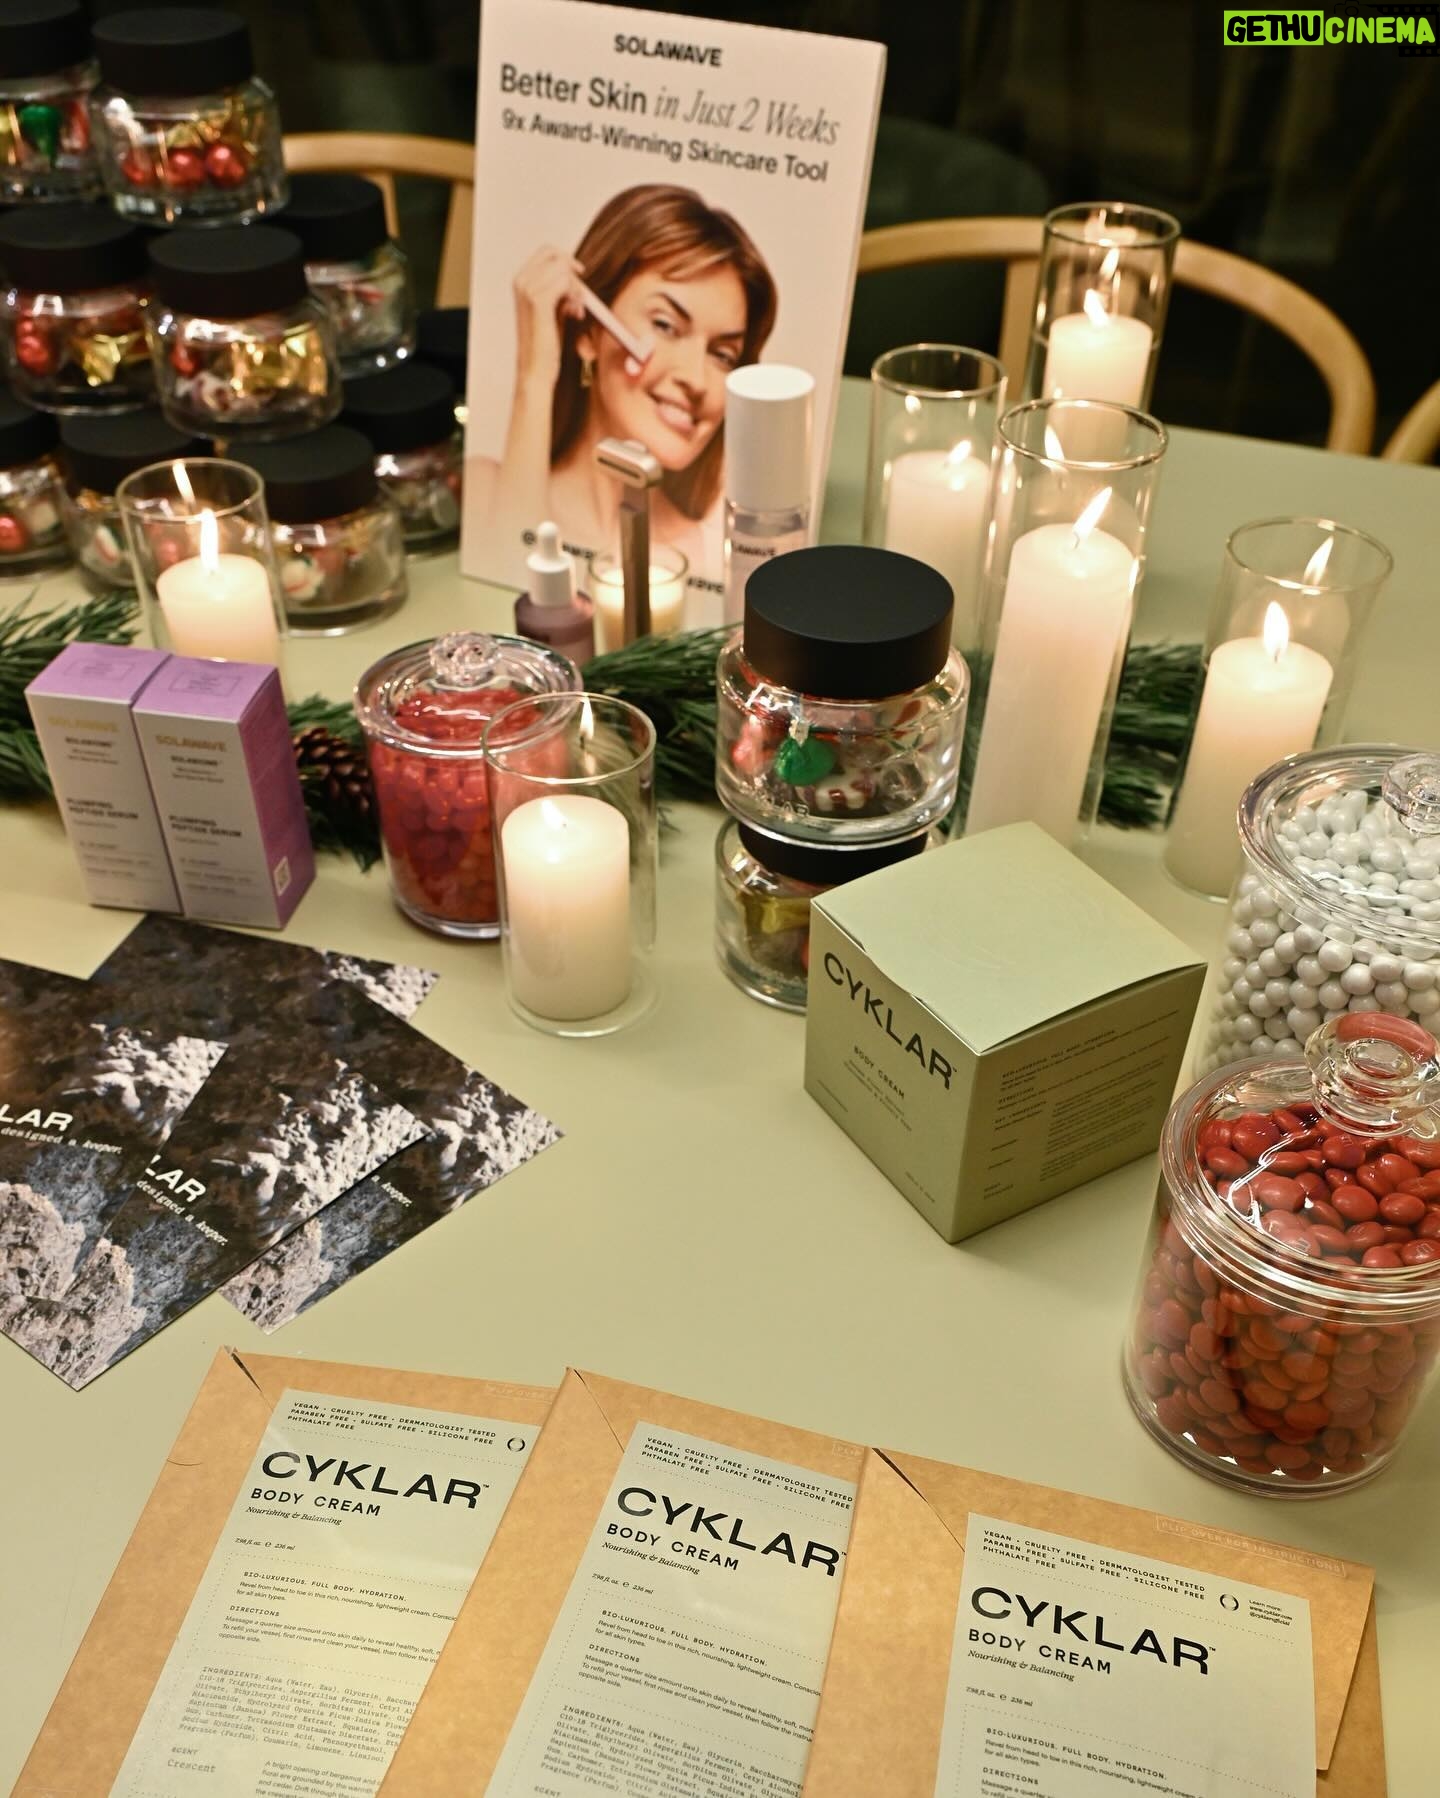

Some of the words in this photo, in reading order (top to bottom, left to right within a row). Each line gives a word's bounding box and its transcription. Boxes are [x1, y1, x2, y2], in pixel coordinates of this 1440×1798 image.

[614, 34, 722, 67] SOLAWAVE
[501, 64, 580, 102] Better
[588, 77, 646, 116] Skin
[654, 86, 678, 120] in
[683, 90, 734, 130] Just
[738, 98, 760, 133] 2
[764, 101, 840, 145] Weeks
[502, 110, 525, 132] 9x
[530, 117, 682, 162] Award-Winning
[688, 140, 778, 174] Skincare
[785, 154, 828, 182] Tool
[854, 1046, 874, 1069] BODY
[878, 1070, 905, 1099] CREAM
[1, 1126, 63, 1144] designed
[136, 1180, 186, 1216] designed
[185, 1214, 193, 1222] a
[287, 1415, 331, 1426] PHTHALATE
[290, 1408, 325, 1418] PARABEN
[360, 1419, 392, 1428] SULFATE
[428, 1430, 469, 1440] SILICONE
[330, 1407, 364, 1416] CRUELTY
[399, 1418, 464, 1432] DERMATOLOGIST
[468, 1428, 496, 1437] TESTED
[641, 1451, 685, 1468] PHTHALATE
[690, 1465, 709, 1474] FREE
[644, 1444, 679, 1458] PARABEN
[684, 1455, 703, 1465] FREE
[715, 1465, 747, 1478] SULFATE
[752, 1476, 772, 1485] FREE
[783, 1485, 826, 1502] SILICONE
[830, 1499, 850, 1509] FREE
[647, 1437, 672, 1448] VEGAN
[684, 1448, 718, 1461] CRUELTY
[722, 1459, 742, 1469] FREE
[754, 1468, 820, 1492] DERMATOLOGIST
[824, 1489, 853, 1502] TESTED
[245, 1506, 290, 1518] Nourishing
[300, 1513, 342, 1526] Balancing
[250, 1487, 304, 1504] BODY
[314, 1496, 380, 1516] CREAM
[601, 1541, 648, 1560] Nourishing
[657, 1557, 700, 1575] Balancing
[606, 1523, 660, 1546] BODY
[671, 1541, 739, 1570] CREAM
[983, 1545, 1029, 1562] PHTHALATE
[1035, 1559, 1055, 1568] FREE
[984, 1530, 1011, 1541] VEGAN
[1024, 1540, 1060, 1553] CRUELTY
[1066, 1551, 1086, 1560] FREE
[1099, 1559, 1170, 1582] DERMATOLOGIST
[1174, 1579, 1205, 1591] TESTED
[983, 1537, 1020, 1551] PARABEN
[1026, 1548, 1046, 1558] FREE
[1060, 1557, 1094, 1571] SULFATE
[1100, 1568, 1120, 1577] FREE
[1134, 1577, 1178, 1593] SILICONE
[1184, 1590, 1204, 1600] FREE
[229, 1605, 279, 1616] DIRECTIONS
[670, 1630, 688, 1640] FULL
[968, 1628, 1025, 1651] BODY
[1038, 1645, 1110, 1674] CREAM
[588, 1643, 640, 1663] DIRECTIONS
[967, 1649, 1017, 1668] Nourishing
[1018, 1661, 1028, 1669] &
[1029, 1663, 1075, 1682] Balancing
[1062, 1746, 1081, 1756] FULL
[982, 1767, 1038, 1785] DIRECTIONS
